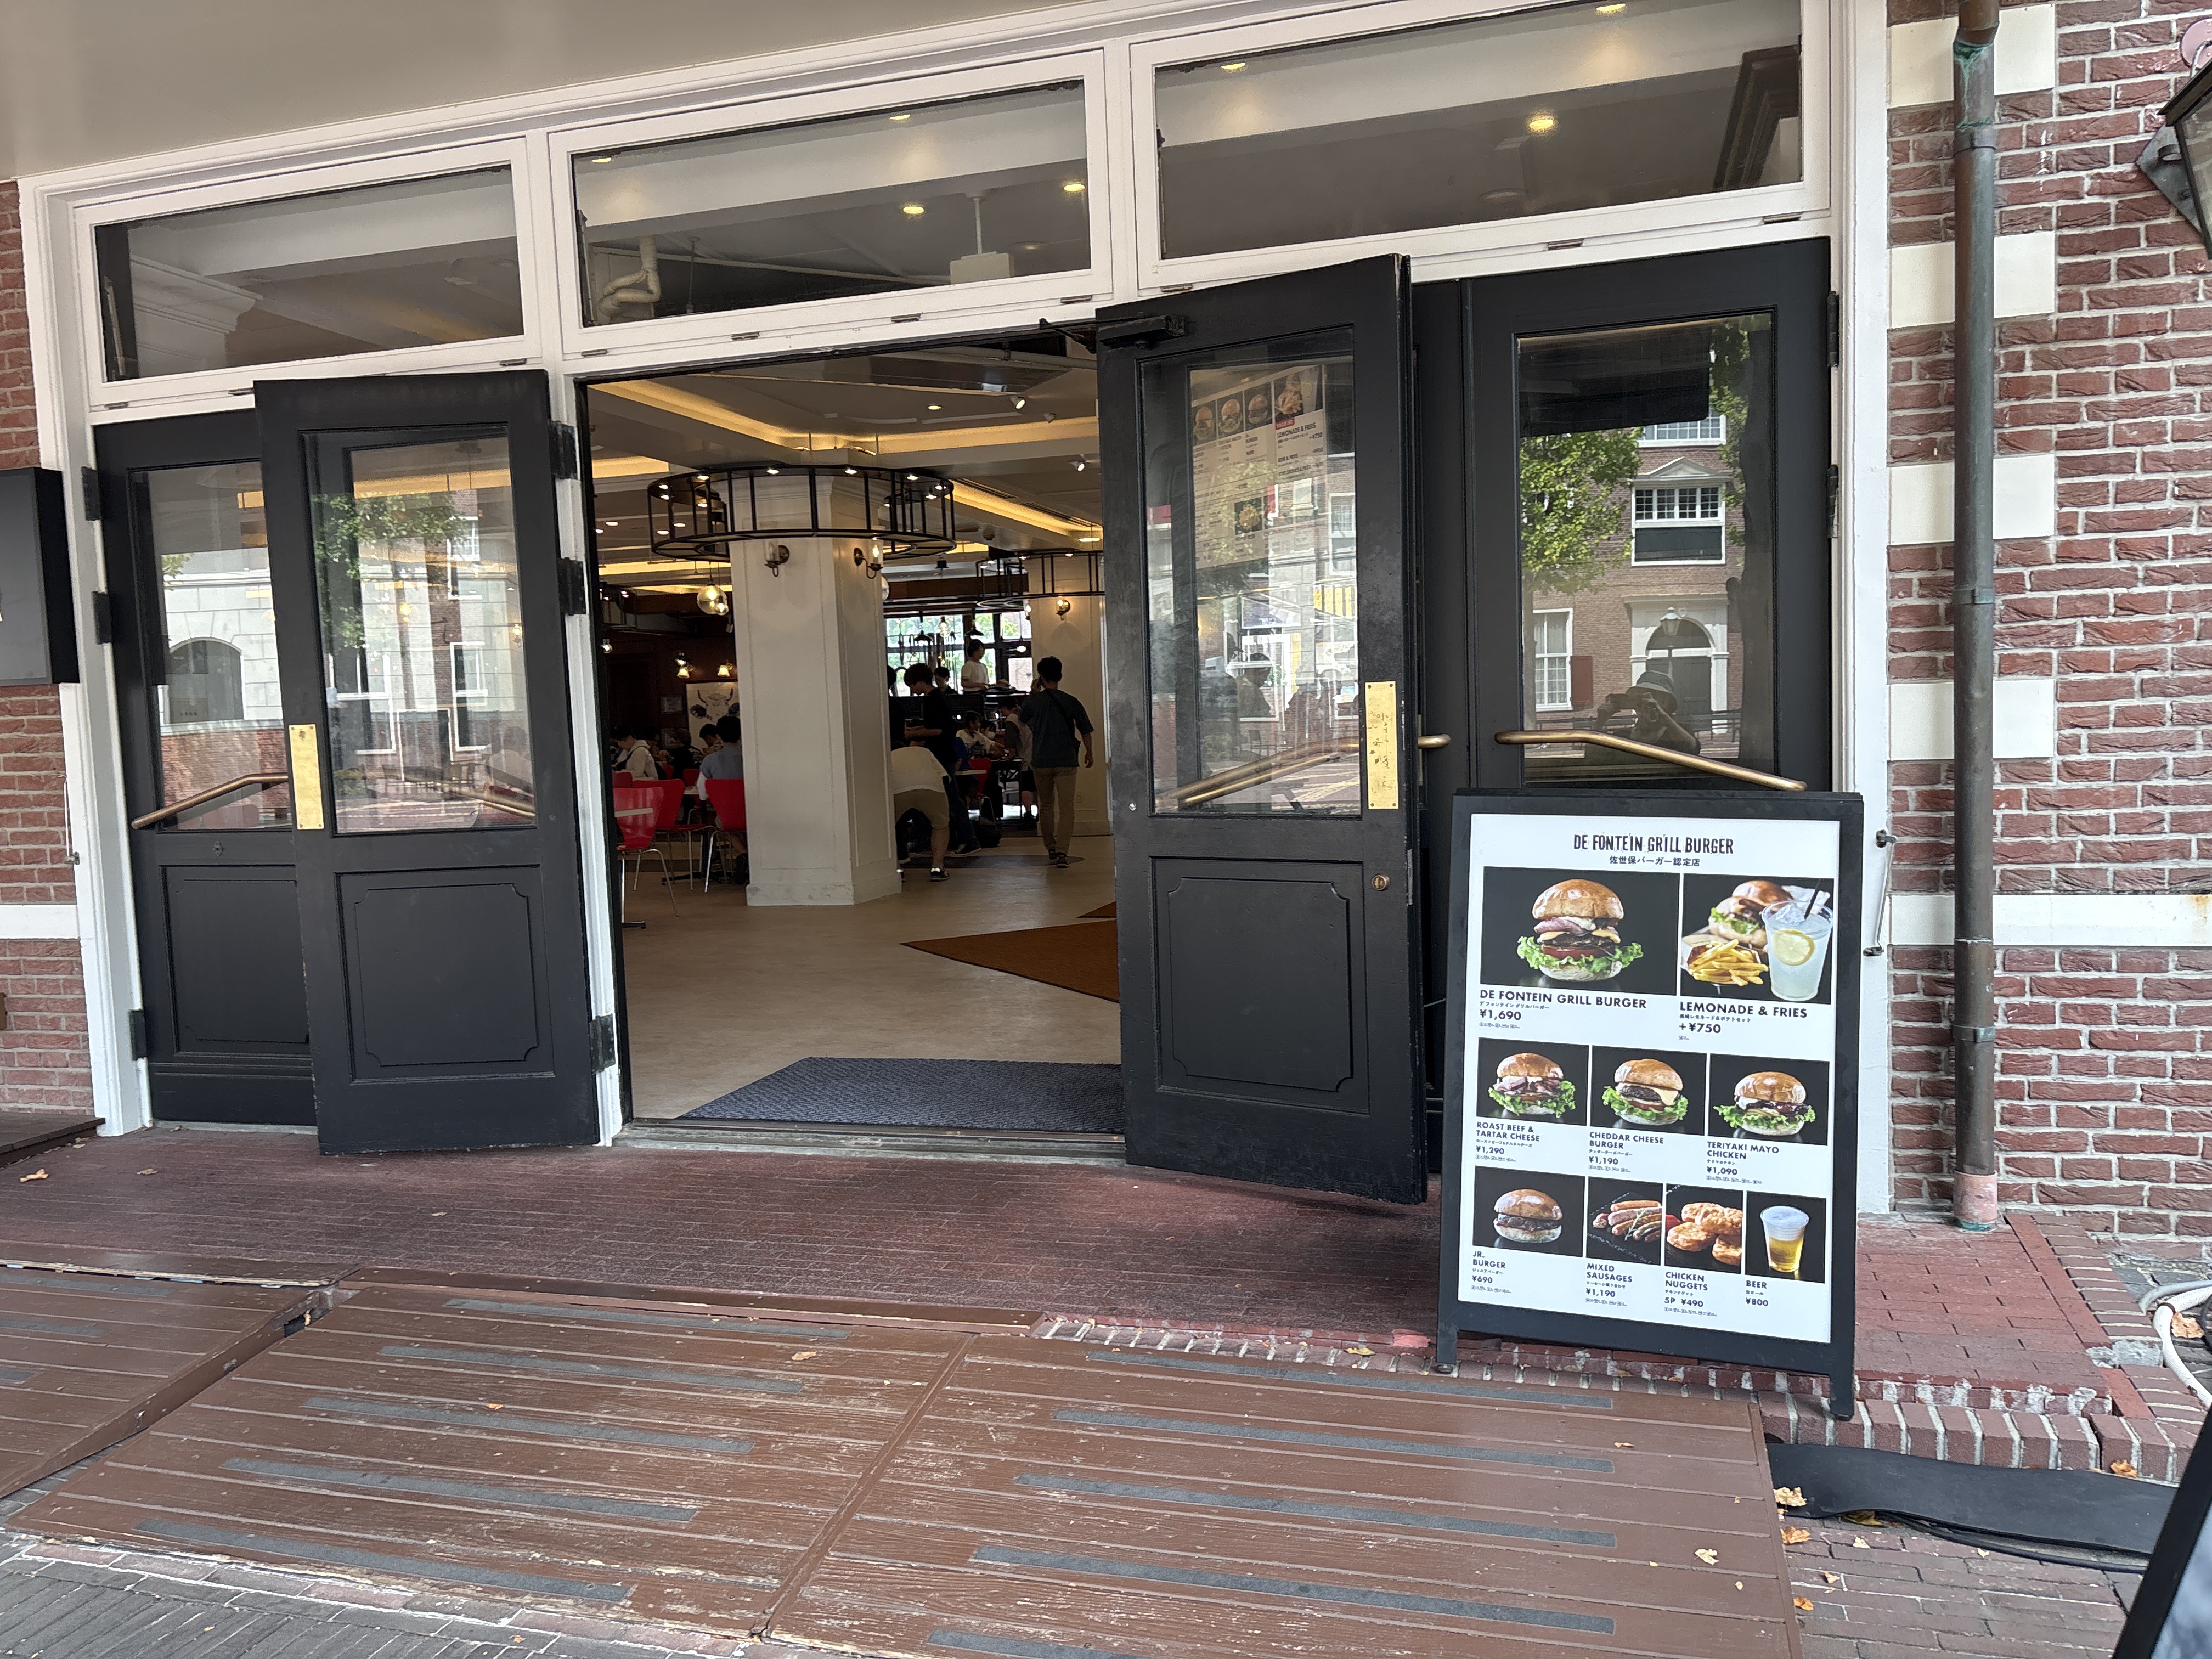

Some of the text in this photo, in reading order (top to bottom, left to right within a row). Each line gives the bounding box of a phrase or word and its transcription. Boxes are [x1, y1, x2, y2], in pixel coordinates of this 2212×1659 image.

[1573, 834, 1734, 854] DE FONTEIN GRILL BURGER
[1609, 855, 1701, 867] 佐世保バーガー認定店
[1480, 990, 1647, 1008] DE FONTEIN GRILL BURGER
[1480, 1009, 1521, 1020] ¥1,690
[1680, 1002, 1807, 1018] LEMONADE & FRIES
[1476, 1130, 1540, 1142] TARTAR CHEESE
[1589, 1132, 1664, 1144] CHEDDAR CHEESE
[1589, 1140, 1623, 1149] BURGER
[1707, 1141, 1779, 1153] TERIYAKI MAYO
[1476, 1146, 1504, 1154] ¥1,290
[1707, 1150, 1746, 1159] CHICKEN
[1589, 1156, 1618, 1165] ¥1,190
[1707, 1166, 1737, 1175] ¥1,090
[1473, 1259, 1506, 1268] BURGER
[1587, 1263, 1615, 1272] MIXED
[1472, 1275, 1492, 1283] ¥690
[1587, 1272, 1632, 1282] SAUSAGES
[1666, 1272, 1704, 1282] CHICKEN
[1666, 1280, 1708, 1290] NUGGETS
[1746, 1280, 1767, 1289] BEER
[1586, 1288, 1615, 1297] ¥1,190
[1681, 1299, 1703, 1307] ¥490
[1746, 1297, 1768, 1306] ¥800
